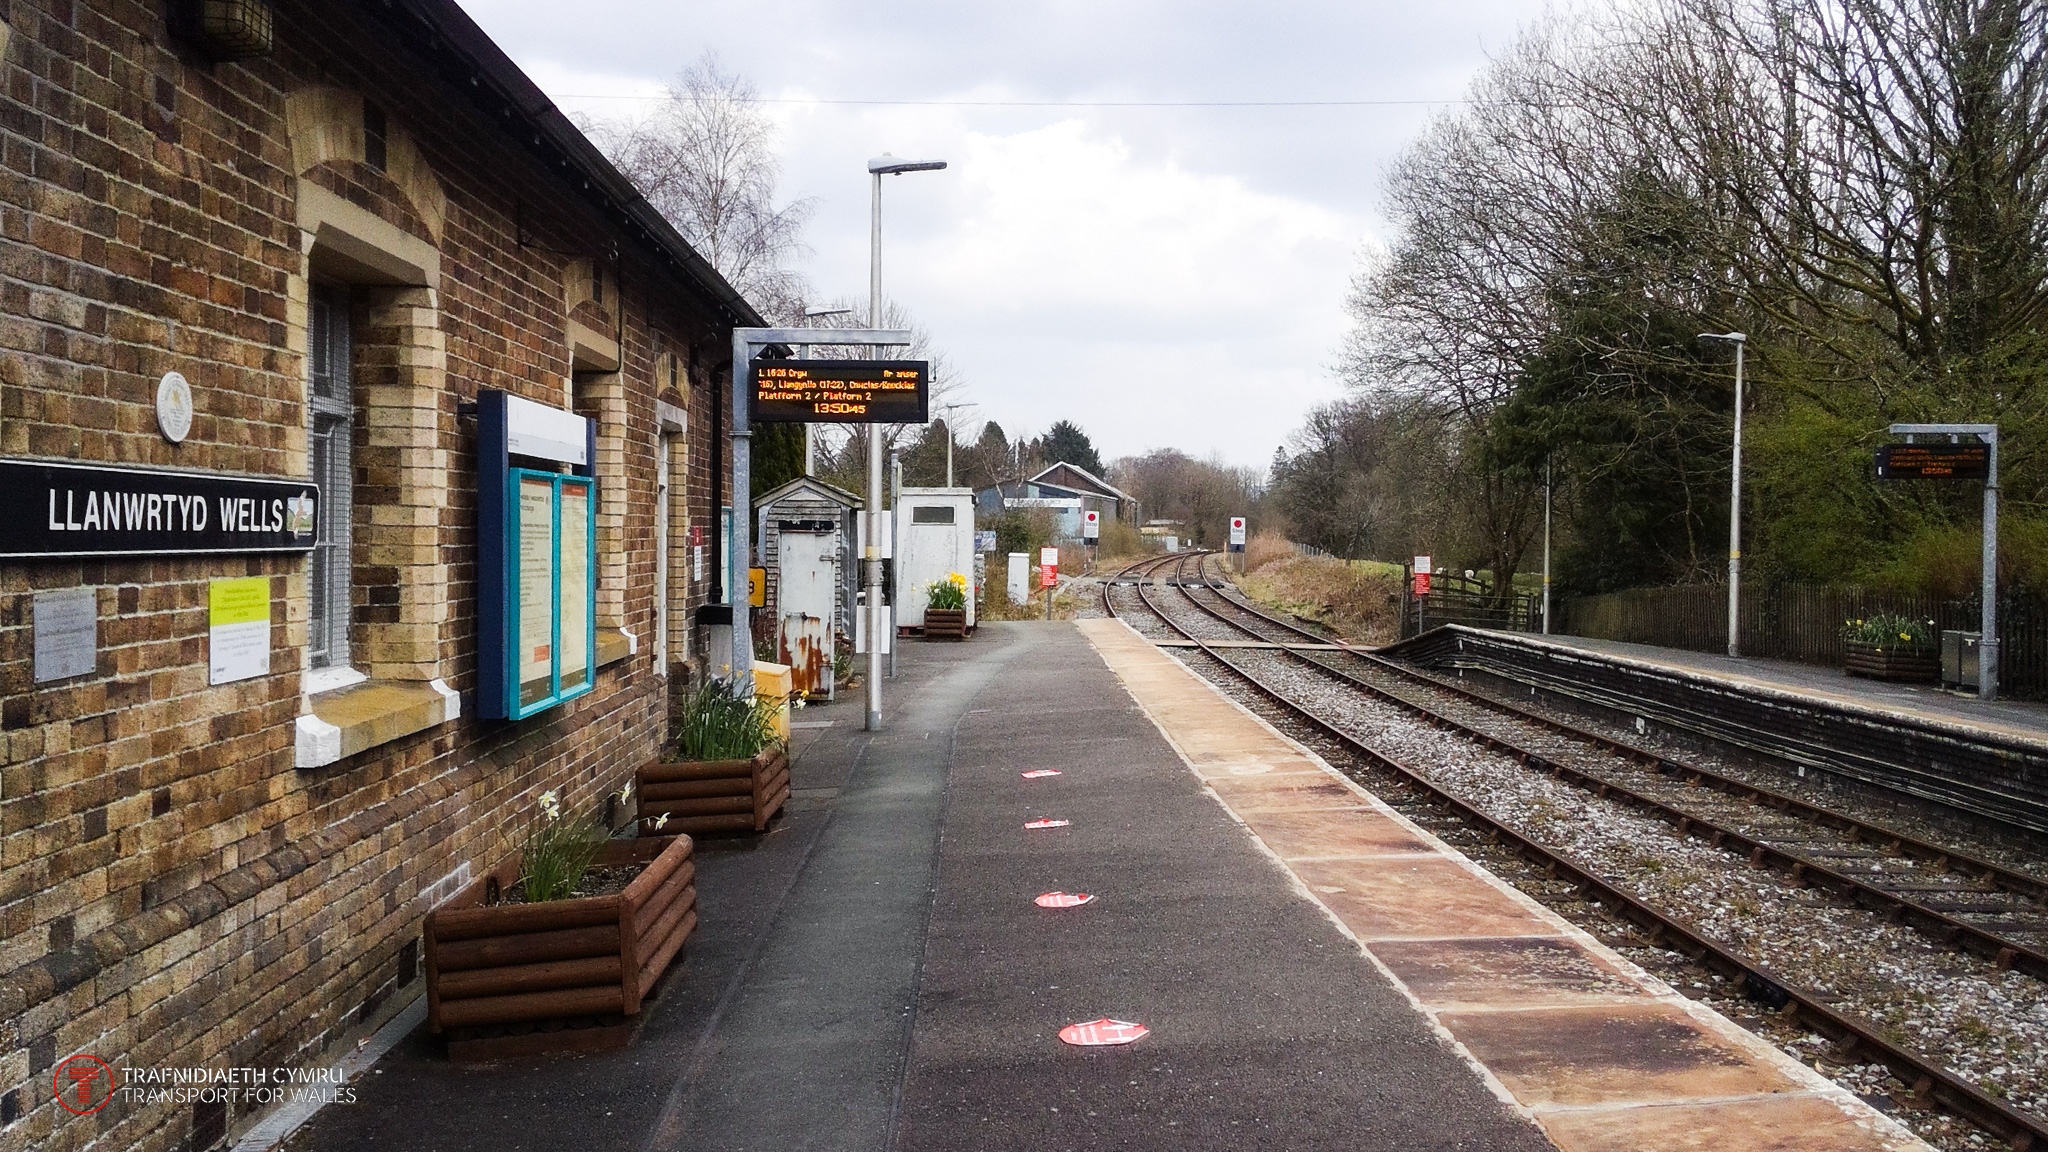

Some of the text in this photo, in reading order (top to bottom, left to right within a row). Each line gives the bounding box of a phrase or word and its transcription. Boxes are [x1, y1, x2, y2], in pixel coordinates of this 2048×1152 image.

[804, 391, 812, 401] 2
[865, 392, 873, 401] 2
[49, 488, 284, 533] LLANWRTYD WELLS
